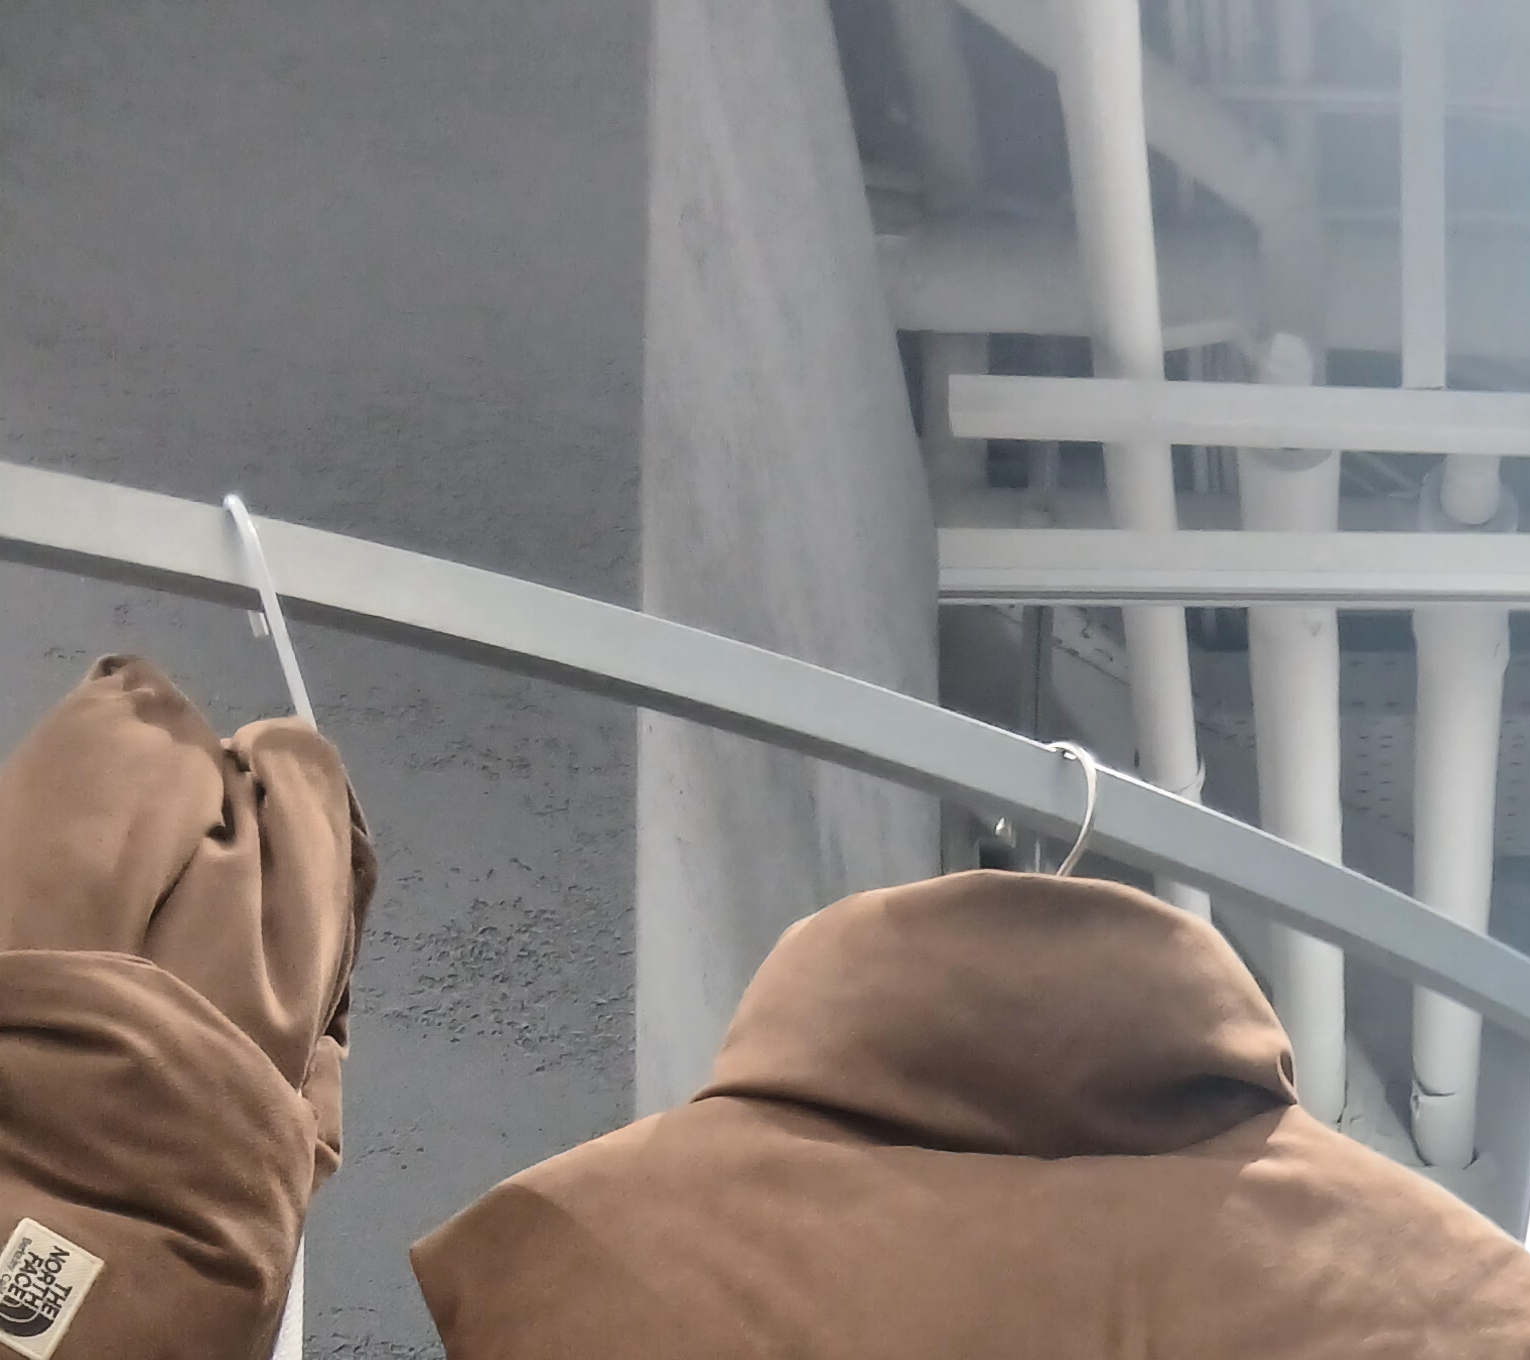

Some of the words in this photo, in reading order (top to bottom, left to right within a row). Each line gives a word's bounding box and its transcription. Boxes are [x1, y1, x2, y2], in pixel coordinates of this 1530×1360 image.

[8, 1251, 43, 1300] FACE
[24, 1245, 70, 1310] NORTH
[41, 1286, 73, 1320] THE
